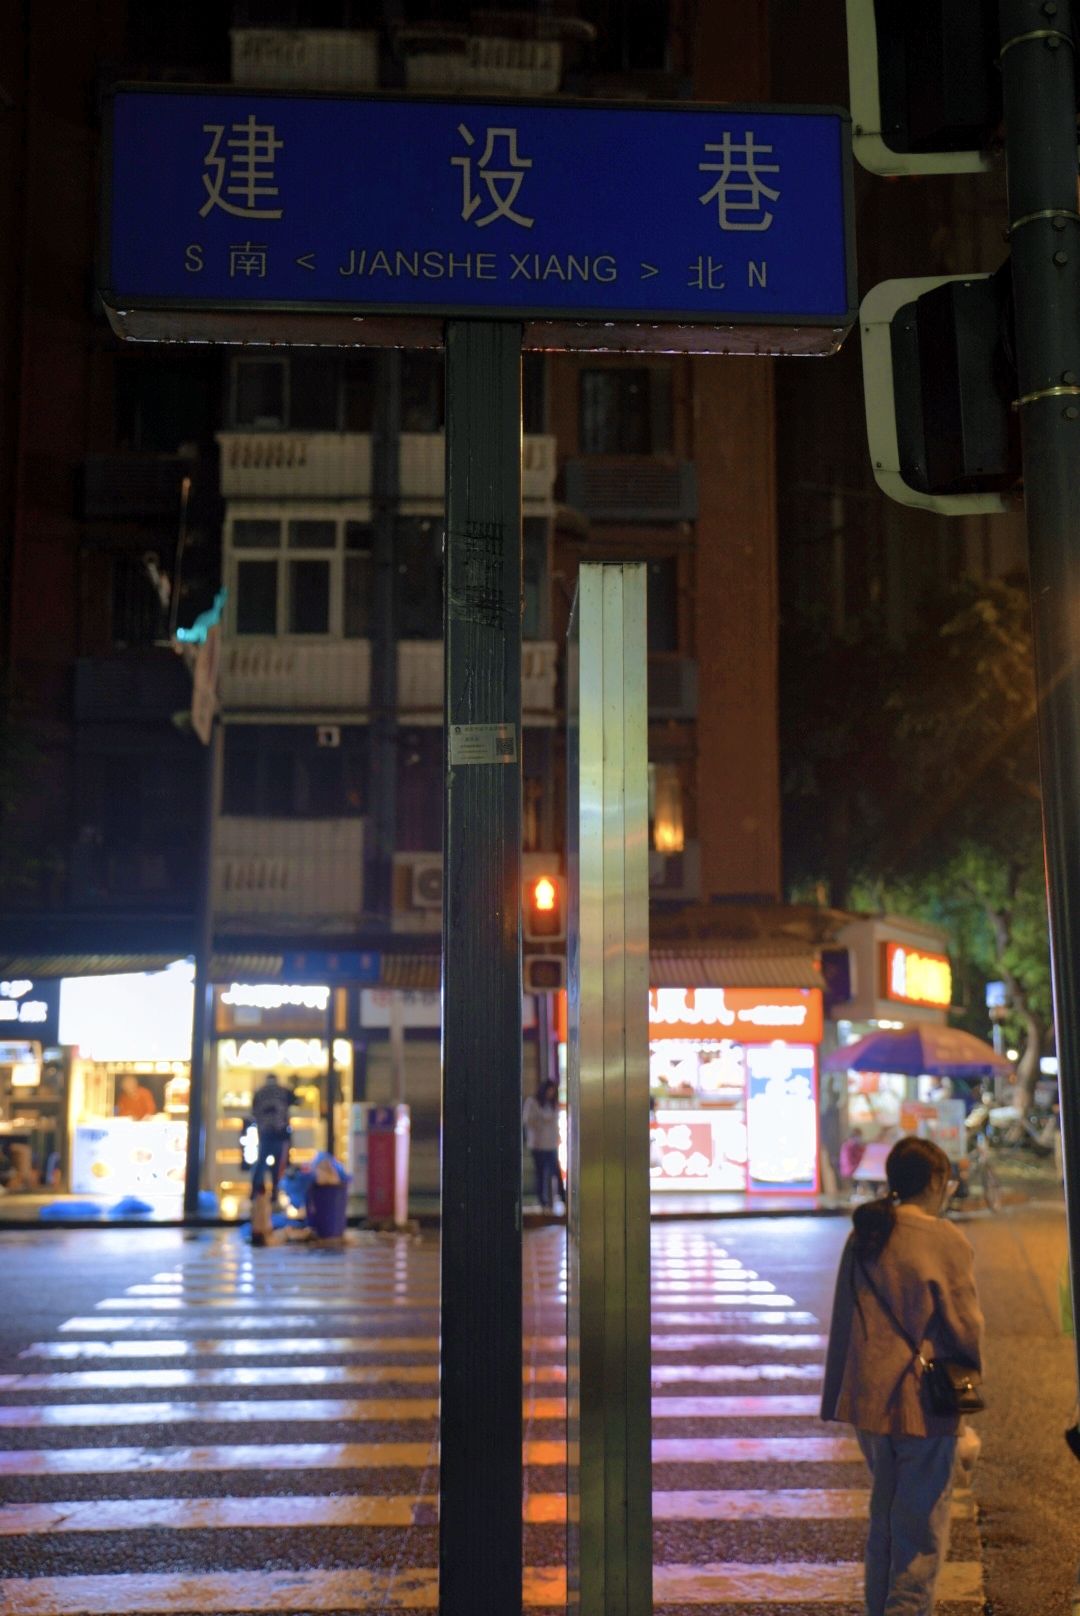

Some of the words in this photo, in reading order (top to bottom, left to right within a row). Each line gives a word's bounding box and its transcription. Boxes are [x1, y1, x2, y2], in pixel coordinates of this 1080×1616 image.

[199, 115, 781, 232] 建设巷
[184, 245, 204, 273] S
[229, 240, 268, 278] 南
[339, 251, 498, 281] JIANSHE
[510, 254, 618, 282] XIANG
[688, 255, 725, 291] 北
[747, 262, 768, 288] N
